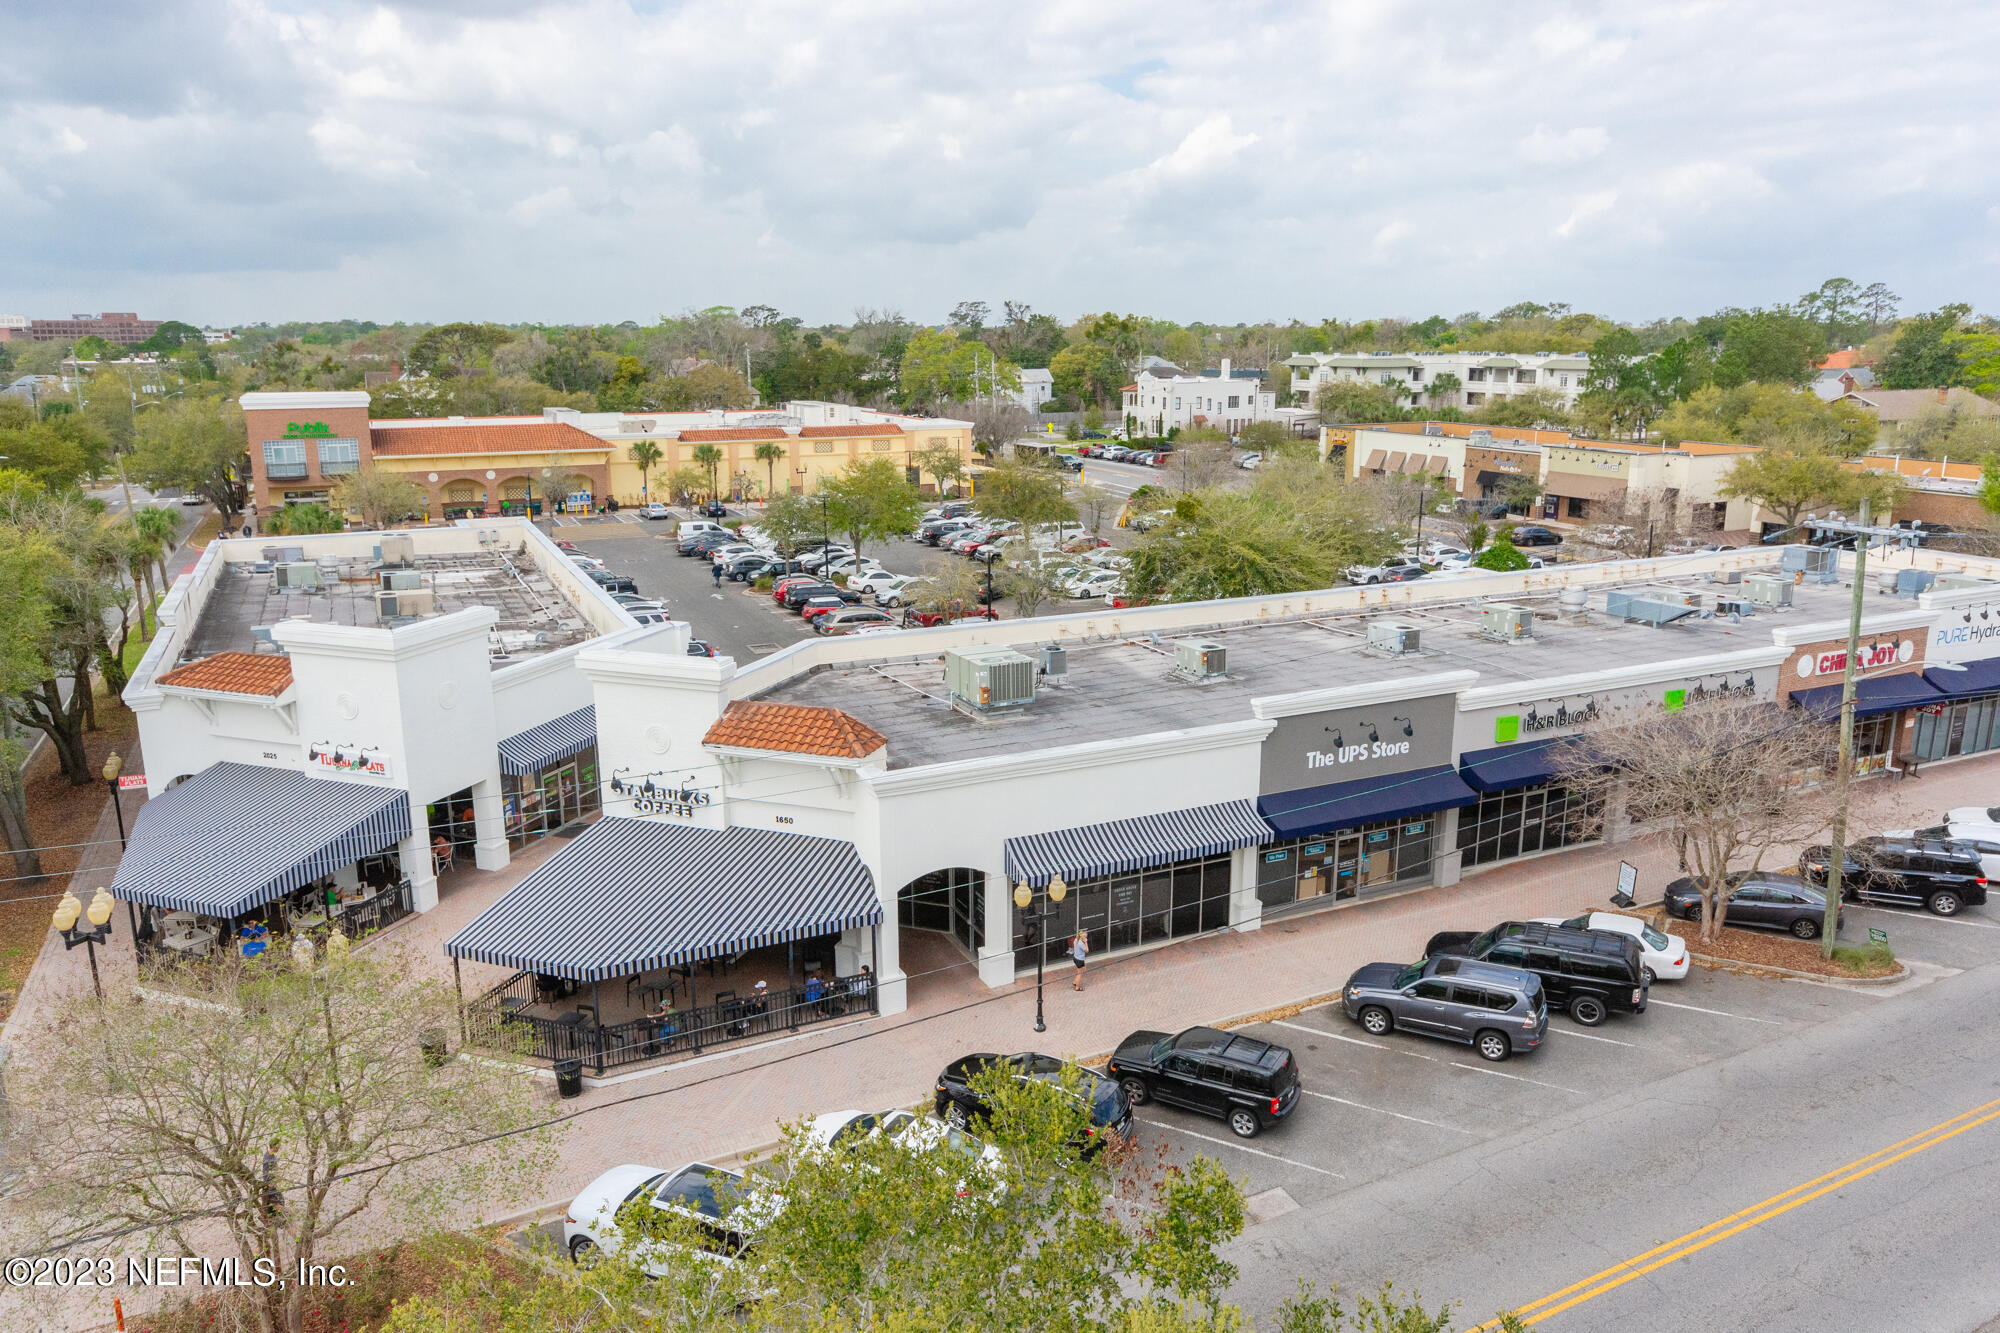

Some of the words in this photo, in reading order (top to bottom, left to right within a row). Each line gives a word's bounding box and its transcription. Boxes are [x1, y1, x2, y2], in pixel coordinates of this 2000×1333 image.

[287, 421, 329, 433] Publix
[1936, 626, 1969, 646] PURE
[1868, 647, 1897, 665] JOY
[1306, 750, 1335, 769] The
[1338, 743, 1369, 764] UPS
[1371, 741, 1410, 759] Store
[632, 799, 693, 818] COFFEE
[775, 815, 794, 825] 1650
